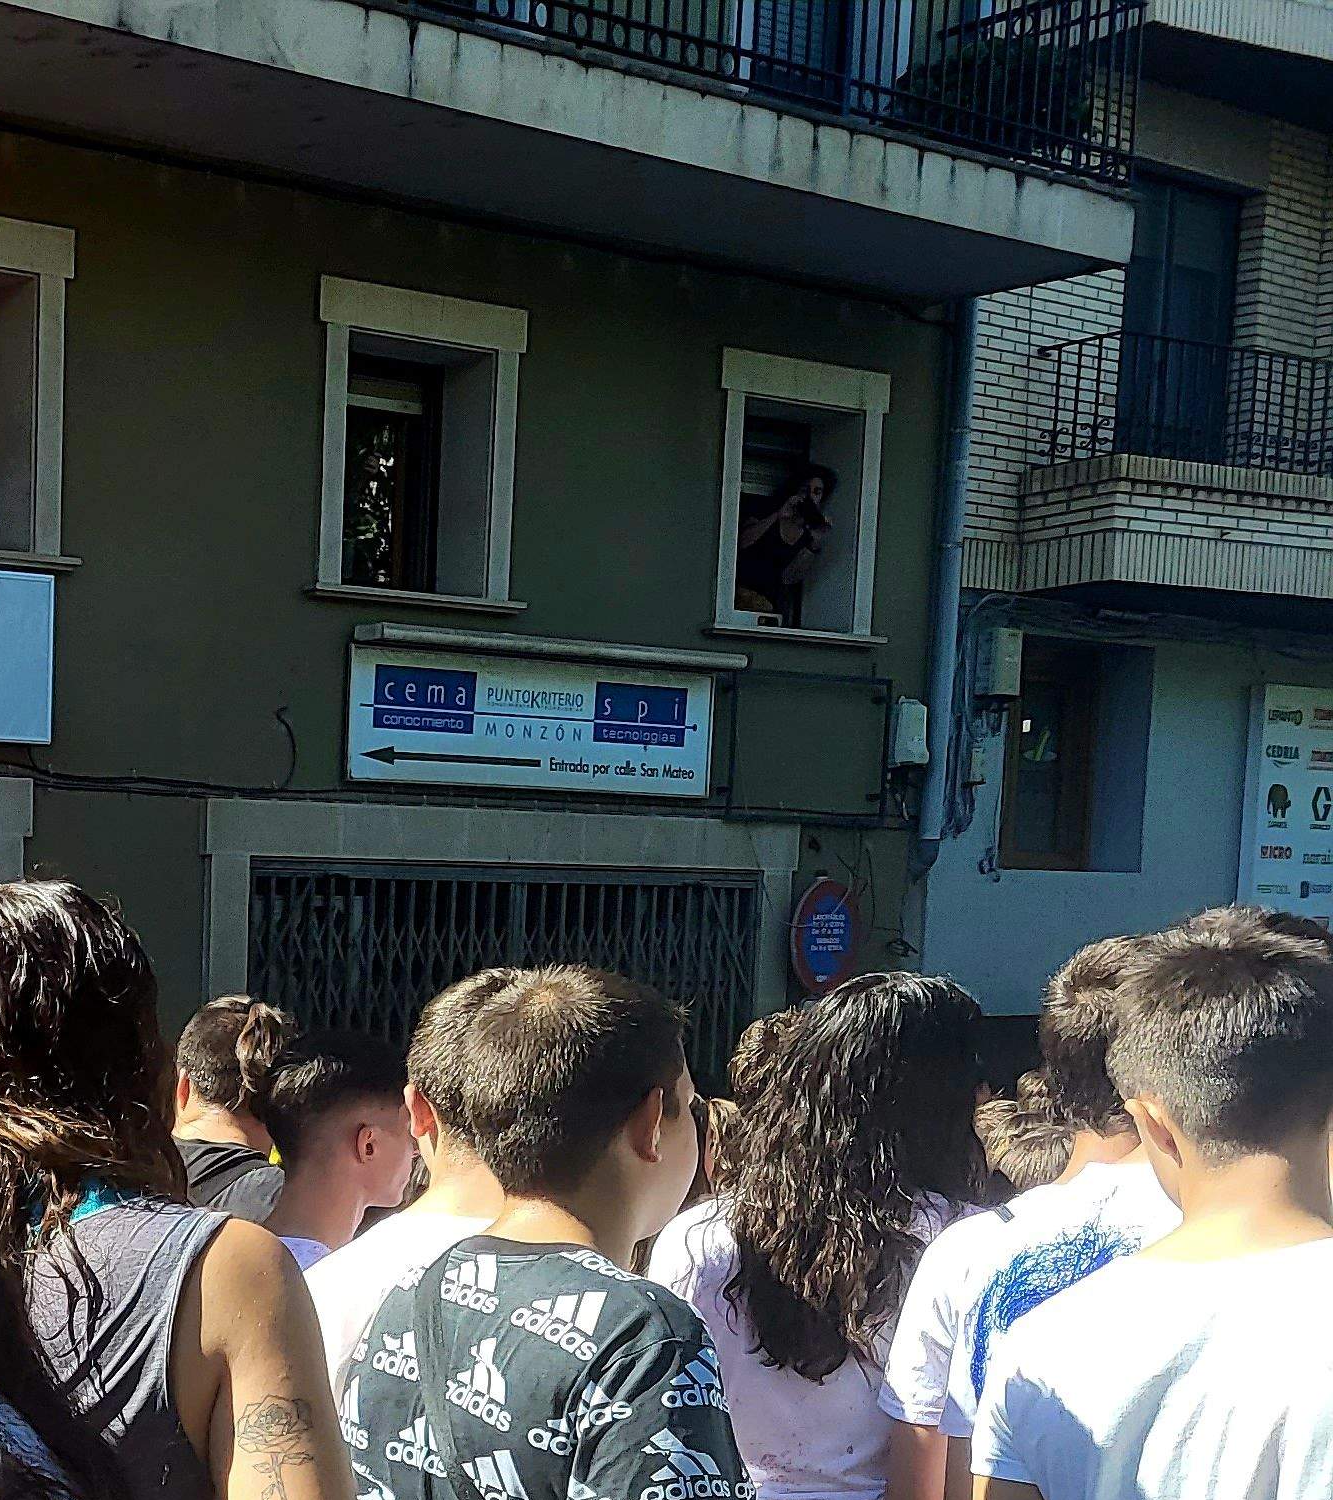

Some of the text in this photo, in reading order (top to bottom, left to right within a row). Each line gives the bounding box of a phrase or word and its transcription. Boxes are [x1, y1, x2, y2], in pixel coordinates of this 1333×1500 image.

[384, 679, 466, 707] cema
[487, 687, 584, 709] PUNTOKRITERIO
[549, 757, 695, 780] Entrada por calle San Mateo
[440, 1278, 501, 1314] didas
[510, 1304, 598, 1362] adidas
